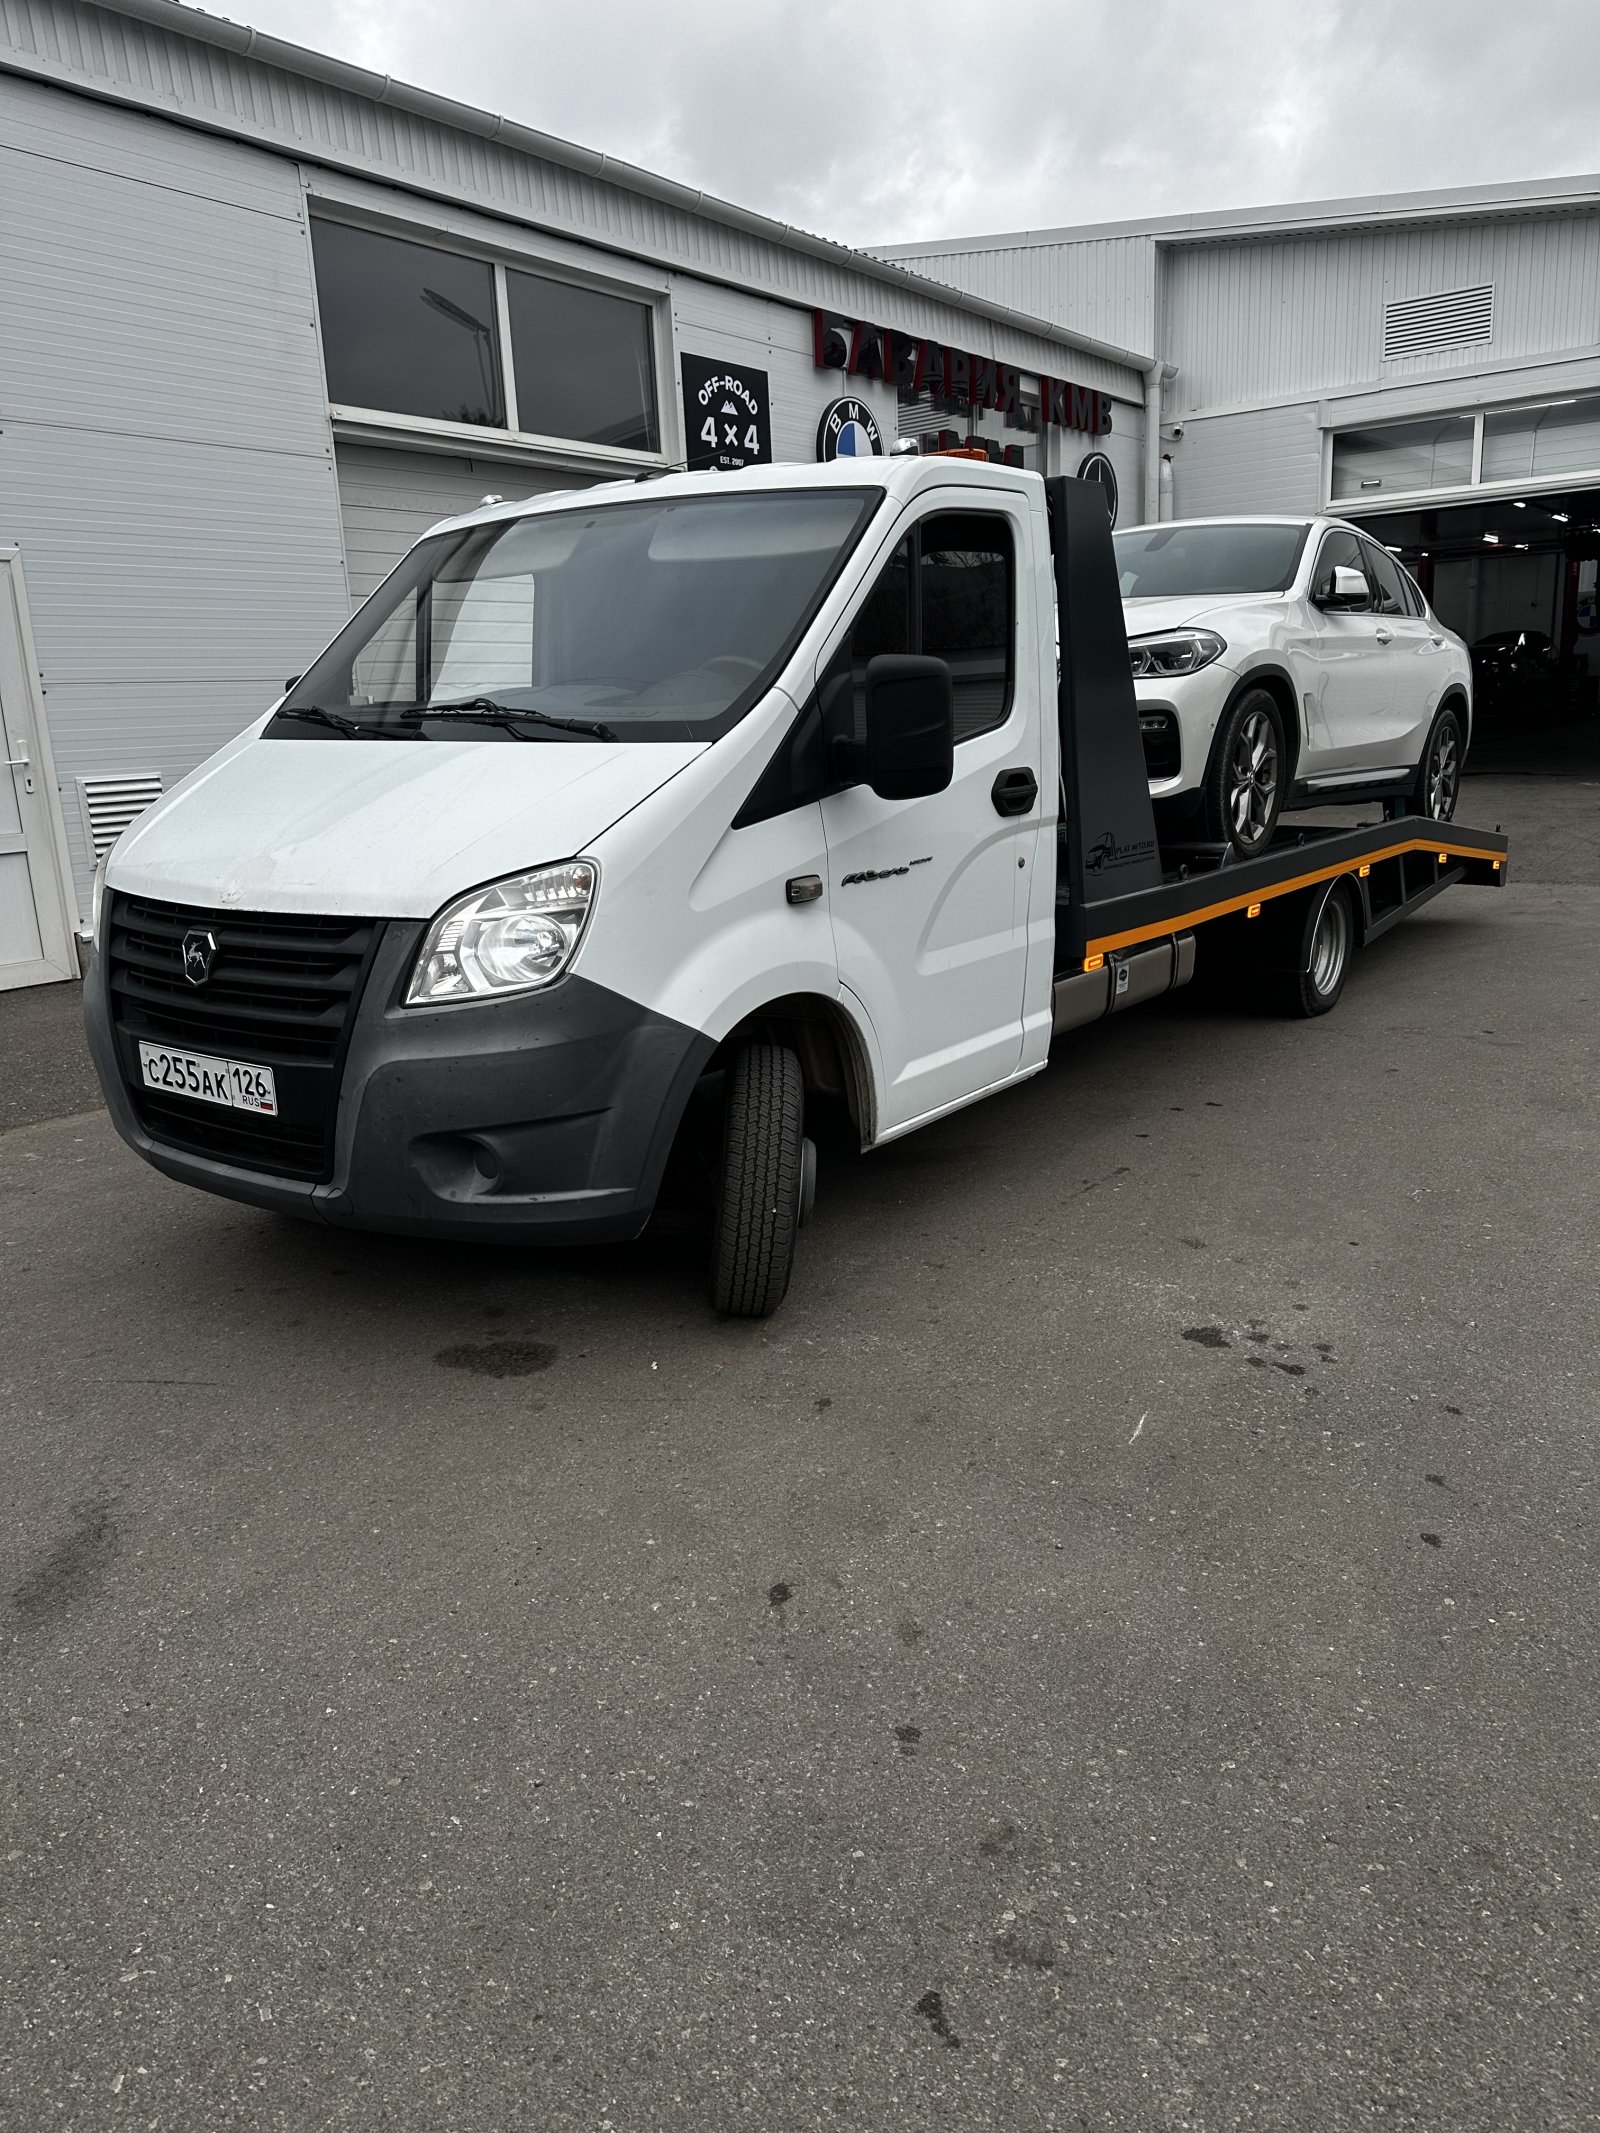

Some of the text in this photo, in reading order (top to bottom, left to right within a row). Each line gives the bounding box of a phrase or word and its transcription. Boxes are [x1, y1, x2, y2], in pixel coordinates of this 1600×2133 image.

[813, 308, 1113, 436] БАВАРИЯ КМВ
[698, 375, 758, 415] OFF-ROAD
[830, 402, 878, 441] BMW
[720, 456, 731, 465] EST.
[232, 1067, 267, 1097] 126
[242, 1095, 260, 1107] RUS
